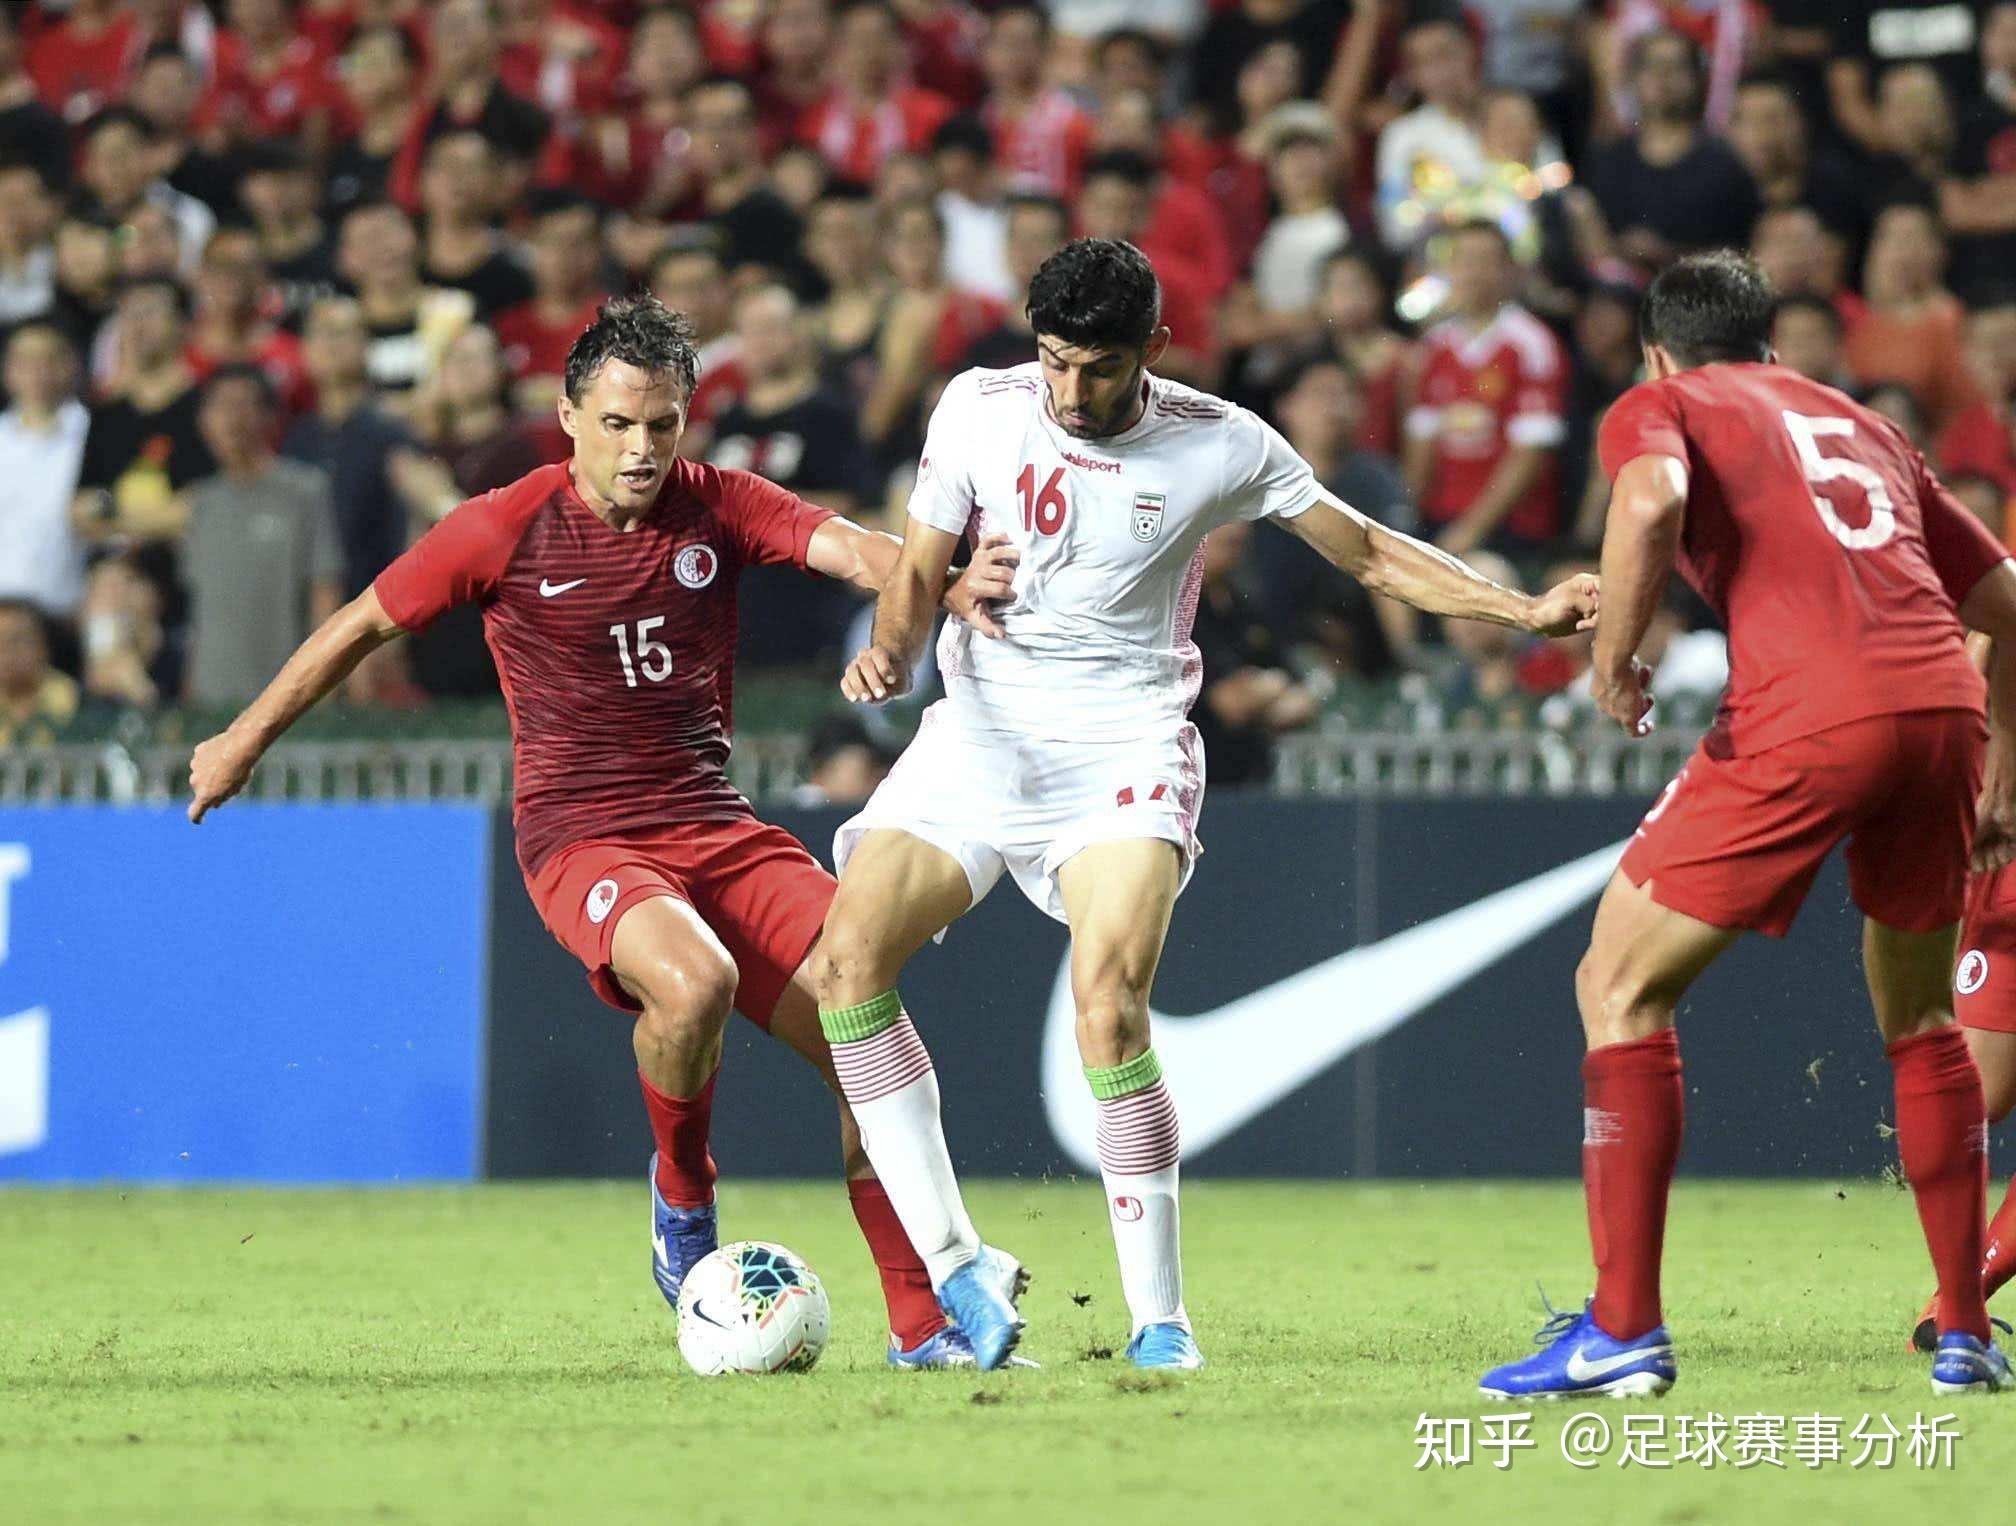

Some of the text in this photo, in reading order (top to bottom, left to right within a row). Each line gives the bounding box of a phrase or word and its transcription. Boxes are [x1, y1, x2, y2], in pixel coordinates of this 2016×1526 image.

[1016, 463, 1067, 536] 16
[1782, 409, 1896, 549] 5
[608, 615, 673, 688] 15
